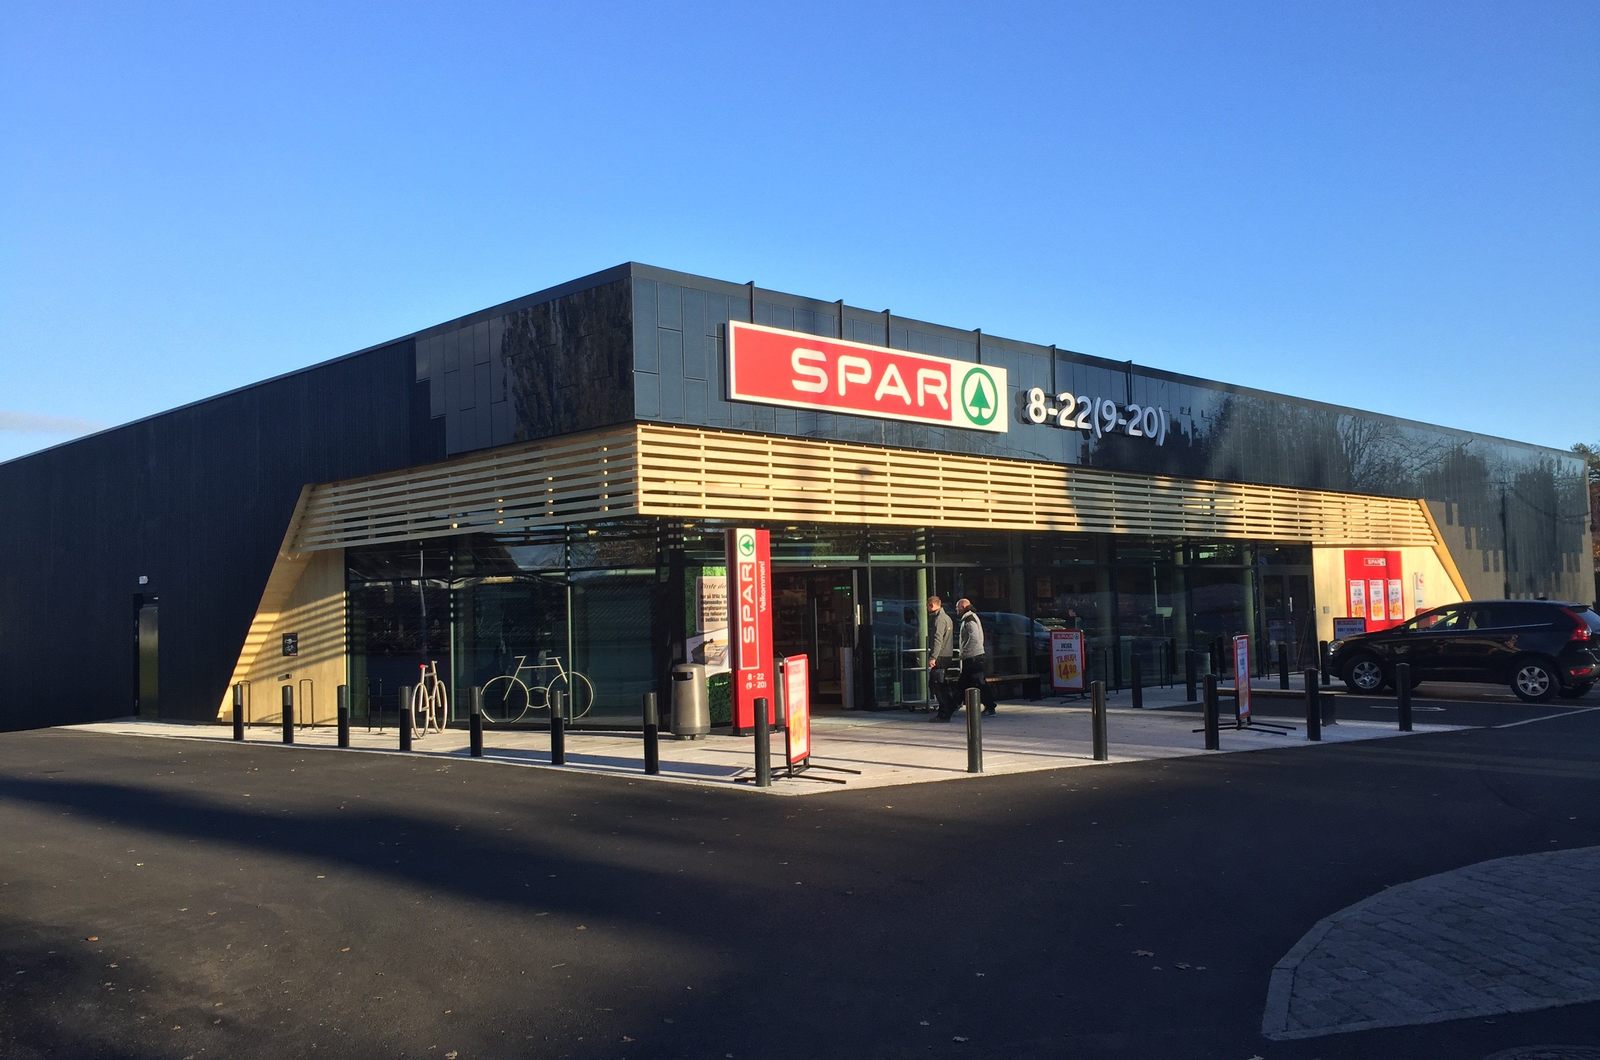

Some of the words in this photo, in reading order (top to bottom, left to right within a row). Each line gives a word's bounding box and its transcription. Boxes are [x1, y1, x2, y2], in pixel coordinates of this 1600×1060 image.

[791, 348, 949, 410] SPAR
[742, 564, 754, 643] SPAR
[756, 672, 765, 680] 22
